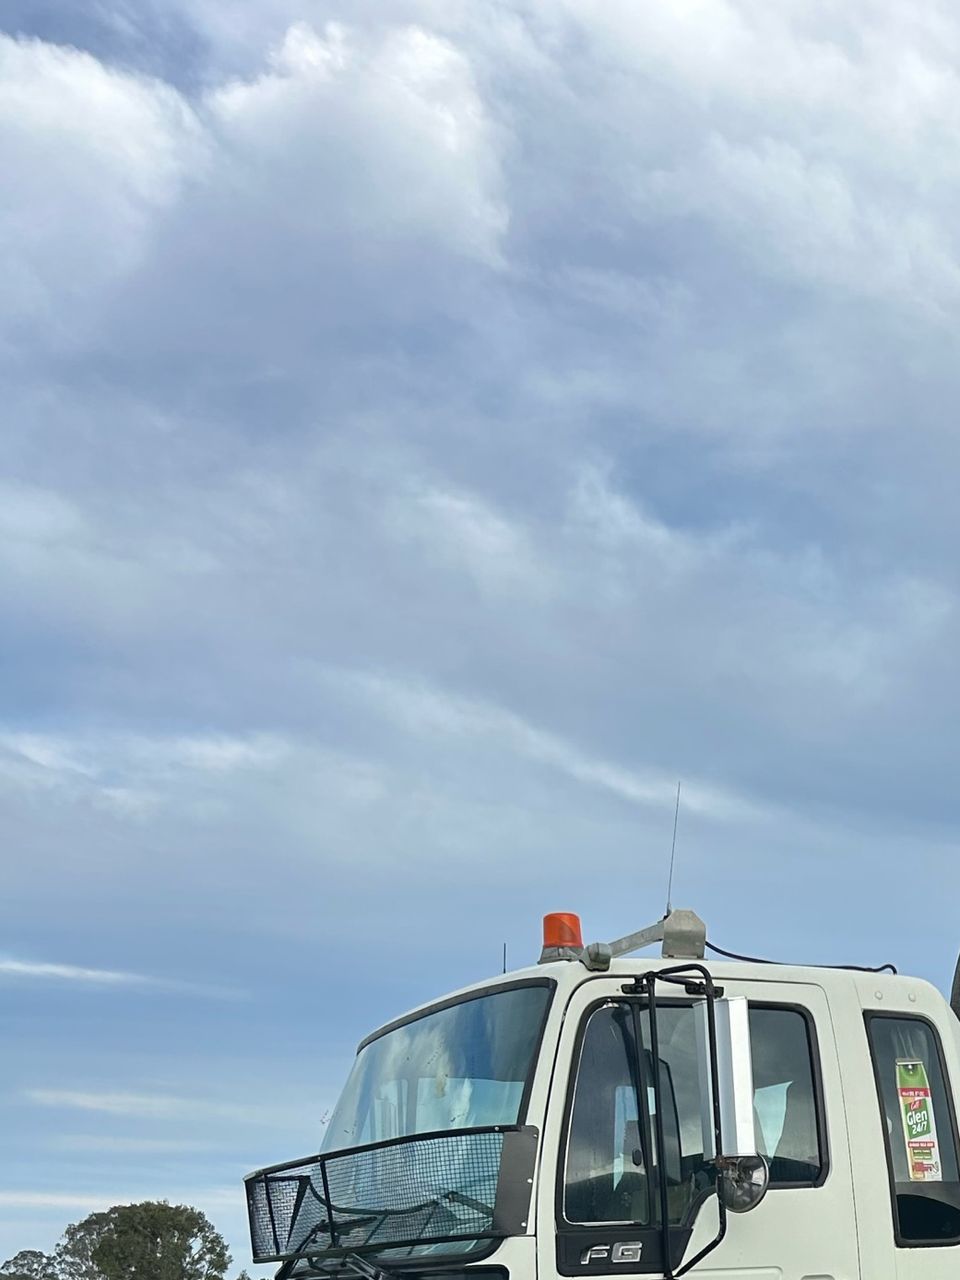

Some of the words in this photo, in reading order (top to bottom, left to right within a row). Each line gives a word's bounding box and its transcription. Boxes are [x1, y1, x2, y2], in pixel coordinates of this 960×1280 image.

[907, 1110, 927, 1125] Glen
[912, 1121, 928, 1134] 24/7
[581, 1241, 642, 1264] FG
